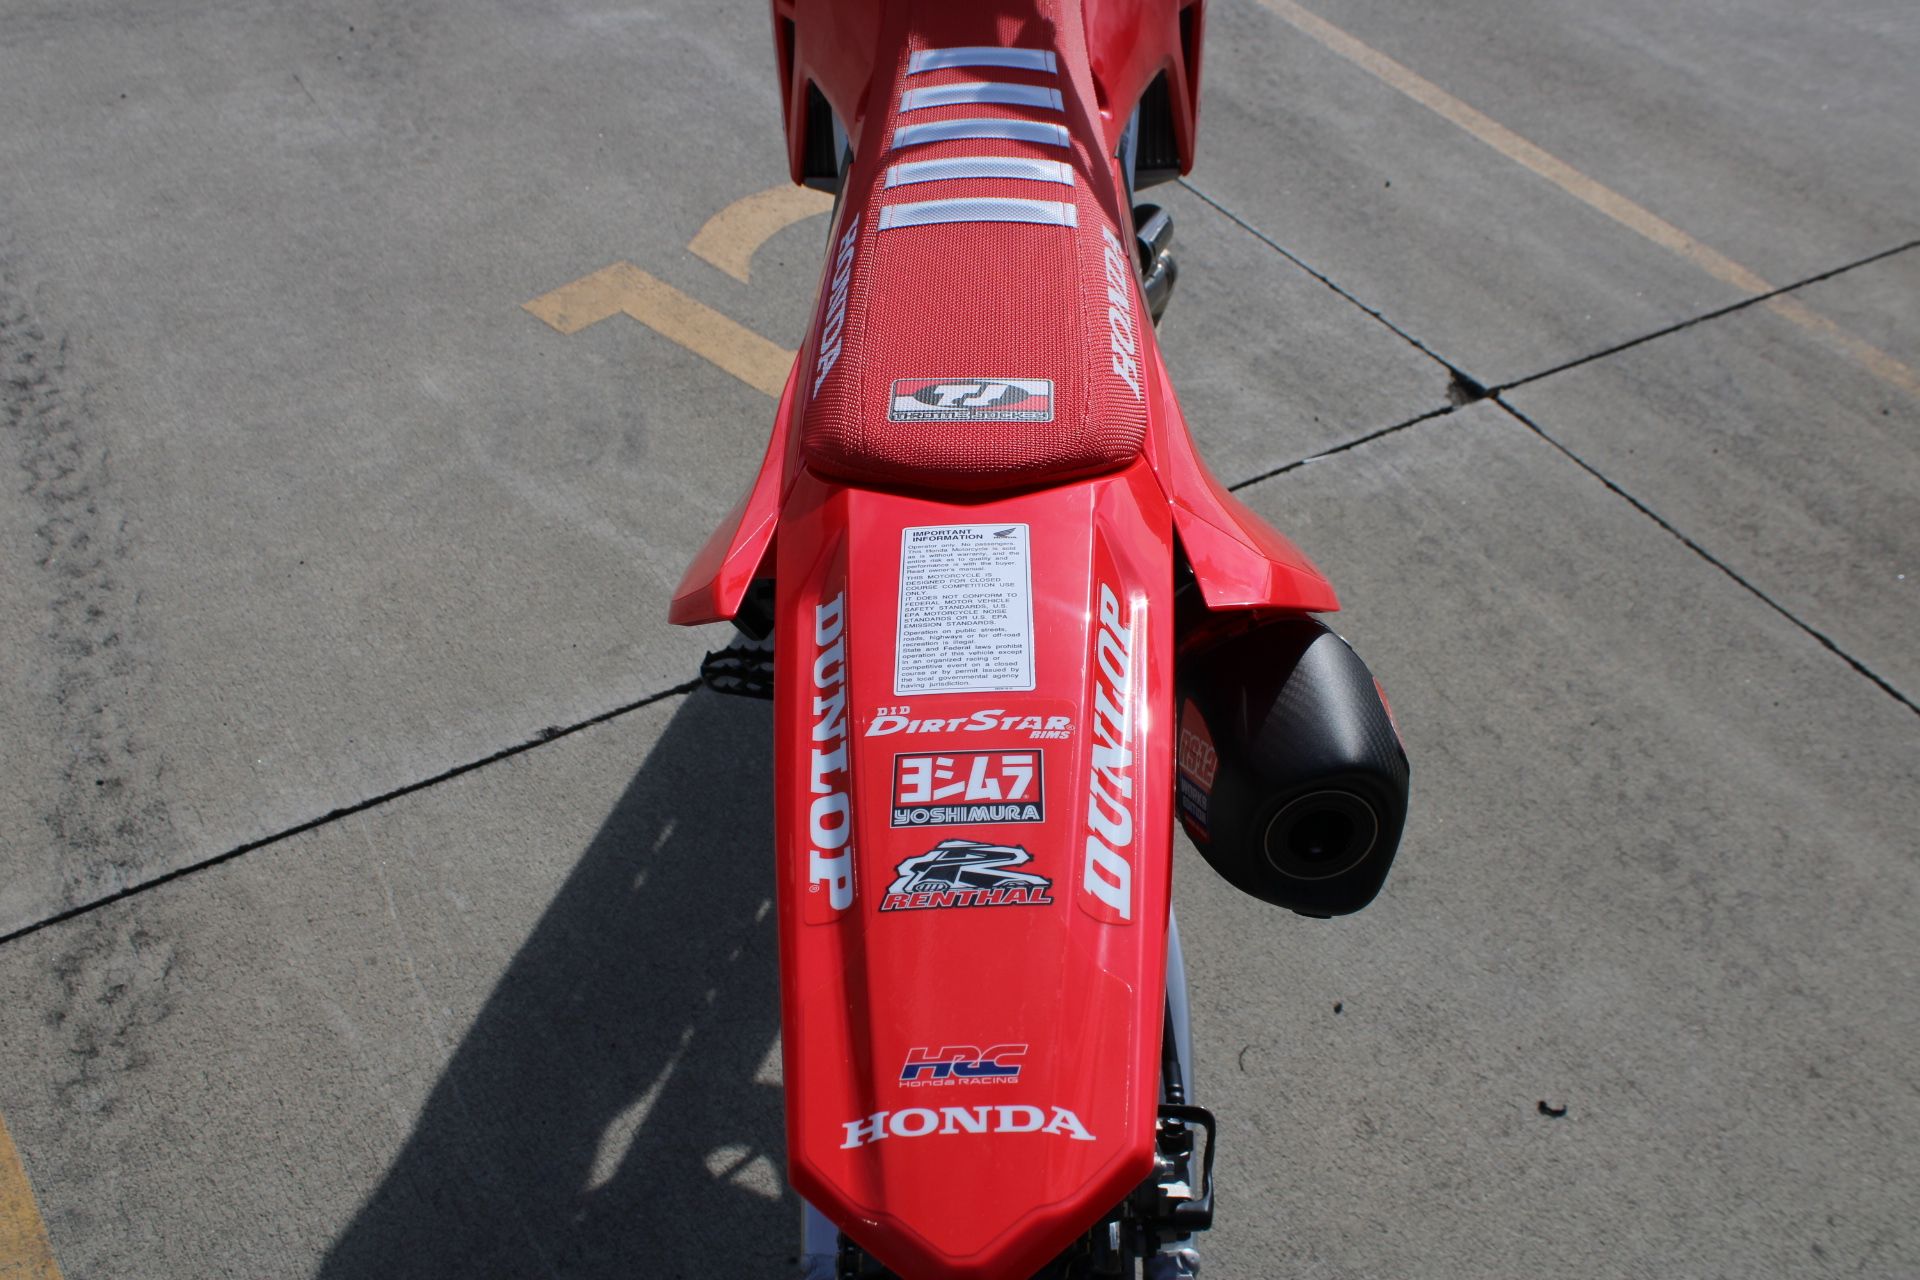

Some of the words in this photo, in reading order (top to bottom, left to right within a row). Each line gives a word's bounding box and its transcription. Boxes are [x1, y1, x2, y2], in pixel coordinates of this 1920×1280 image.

[813, 213, 859, 400] HONDA
[1102, 224, 1140, 401] HONDA
[809, 591, 853, 910] DUNLOP
[1029, 731, 1071, 740] RIMS
[1084, 582, 1135, 920] DUNLOP
[900, 754, 1033, 804] ヨシムラ
[893, 804, 1041, 825] YOSHIMURA
[880, 886, 1052, 911] RENTHAL
[898, 1078, 955, 1088] Honda
[958, 1076, 1019, 1085] RACING
[899, 1043, 1029, 1080] HRC
[840, 1105, 1096, 1149] HONDA
